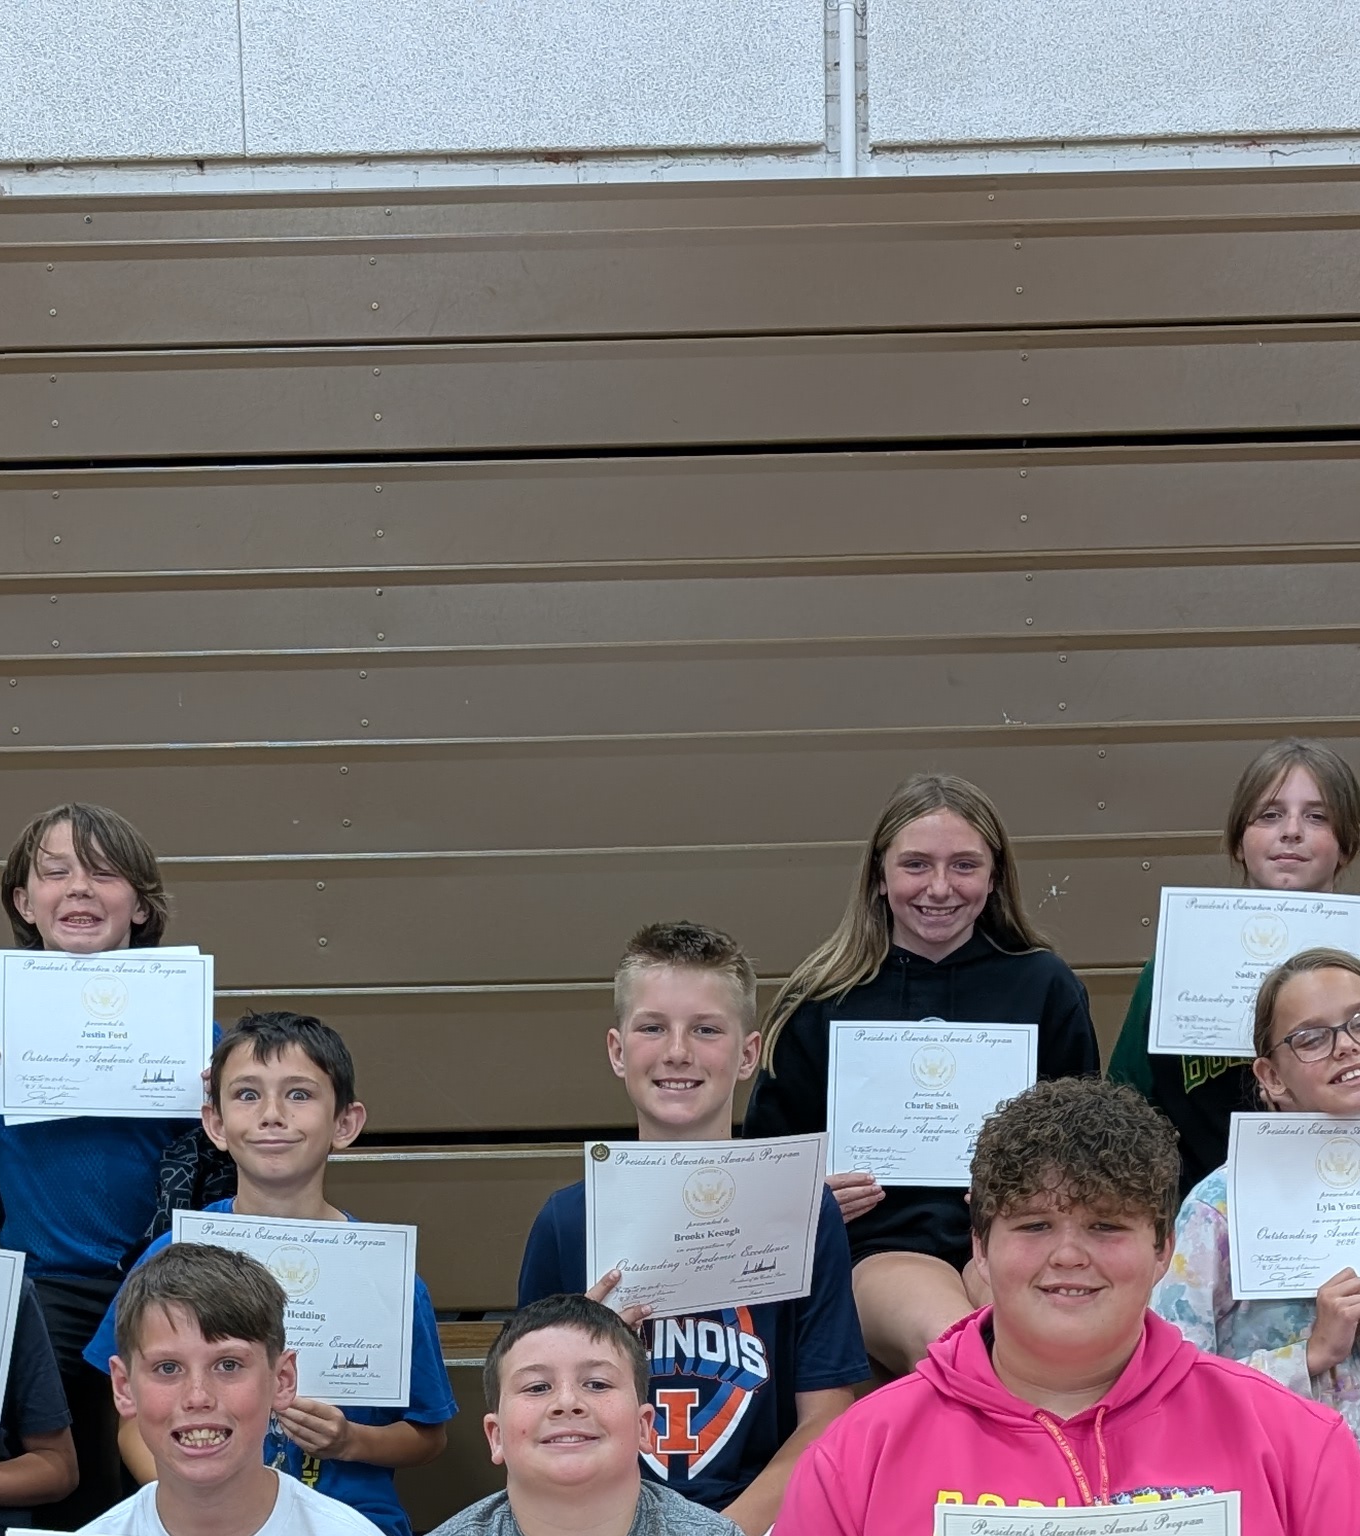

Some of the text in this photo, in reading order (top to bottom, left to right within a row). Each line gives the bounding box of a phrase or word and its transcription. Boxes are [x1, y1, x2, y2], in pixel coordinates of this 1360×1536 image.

[80, 1030, 127, 1038] Justin Ford
[904, 1101, 958, 1109] Charlie Smith
[1257, 1121, 1304, 1135] President's
[1307, 1122, 1348, 1135] Education
[614, 1146, 799, 1166] President's Education Awards Program
[1316, 1202, 1336, 1213] Lyla
[674, 1227, 740, 1241] Brooks Keough
[286, 1310, 326, 1322] Hedding
[654, 1319, 768, 1379] INOIS
[970, 1512, 1204, 1536] President's Education Awards Program
